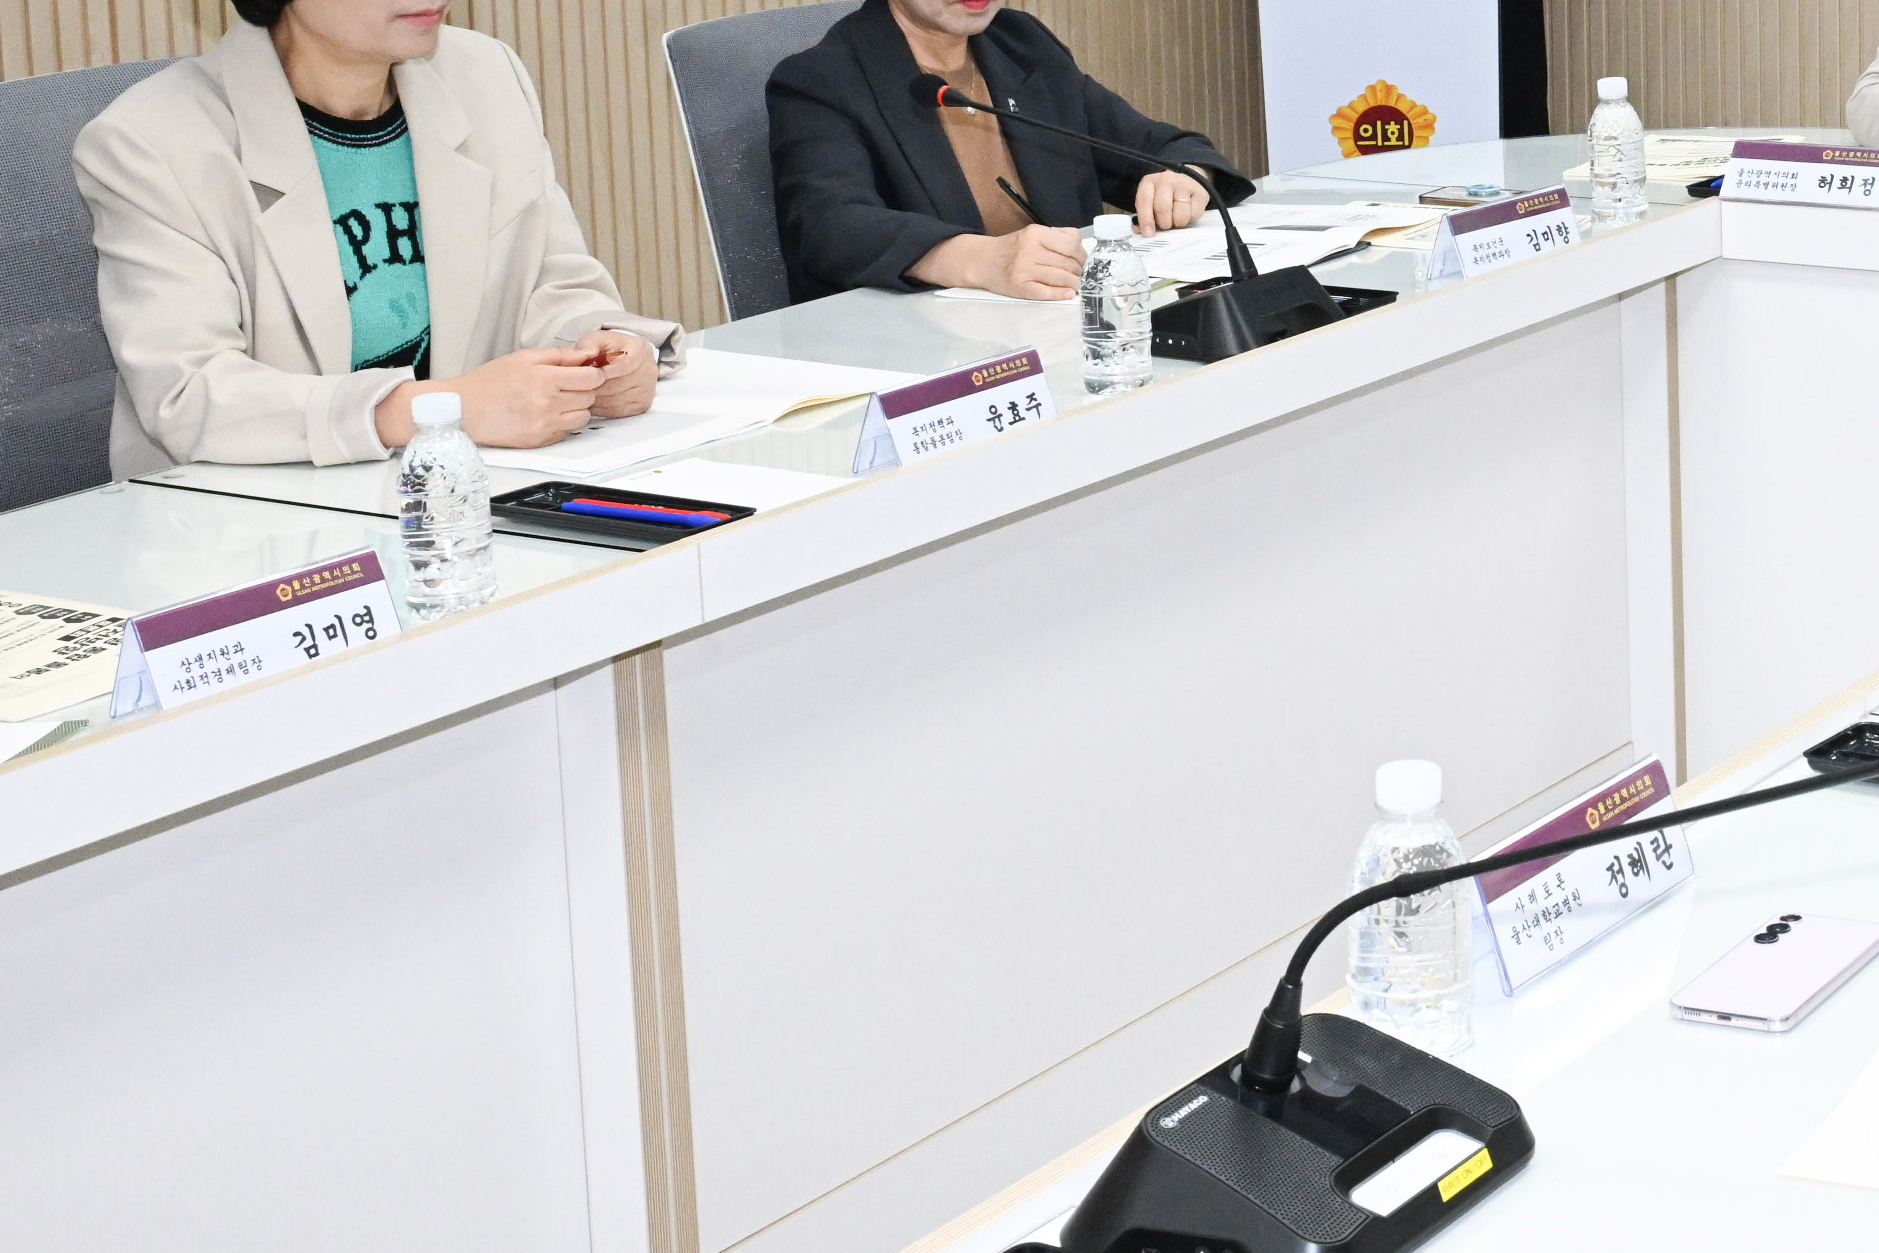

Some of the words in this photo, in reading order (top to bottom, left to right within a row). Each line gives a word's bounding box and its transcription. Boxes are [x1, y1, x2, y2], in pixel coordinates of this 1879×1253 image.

[1357, 120, 1409, 146] 의회
[1818, 174, 1875, 196] 허희정
[1526, 222, 1570, 252] 김미향
[912, 416, 954, 436] 복지정책과
[987, 392, 1041, 432] 윤효주
[913, 429, 963, 454] 통합돌봄팀장
[292, 563, 360, 590] 울산광역시의회
[293, 606, 377, 659] 김미영
[181, 641, 245, 673] 상생지원과
[173, 656, 262, 692] 사회적경제팀장
[1598, 775, 1652, 814] 울산광역시의회
[1607, 831, 1673, 898] 정혜란
[1512, 889, 1582, 945] 울산대학교병원
[1543, 925, 1564, 951] 팀장
